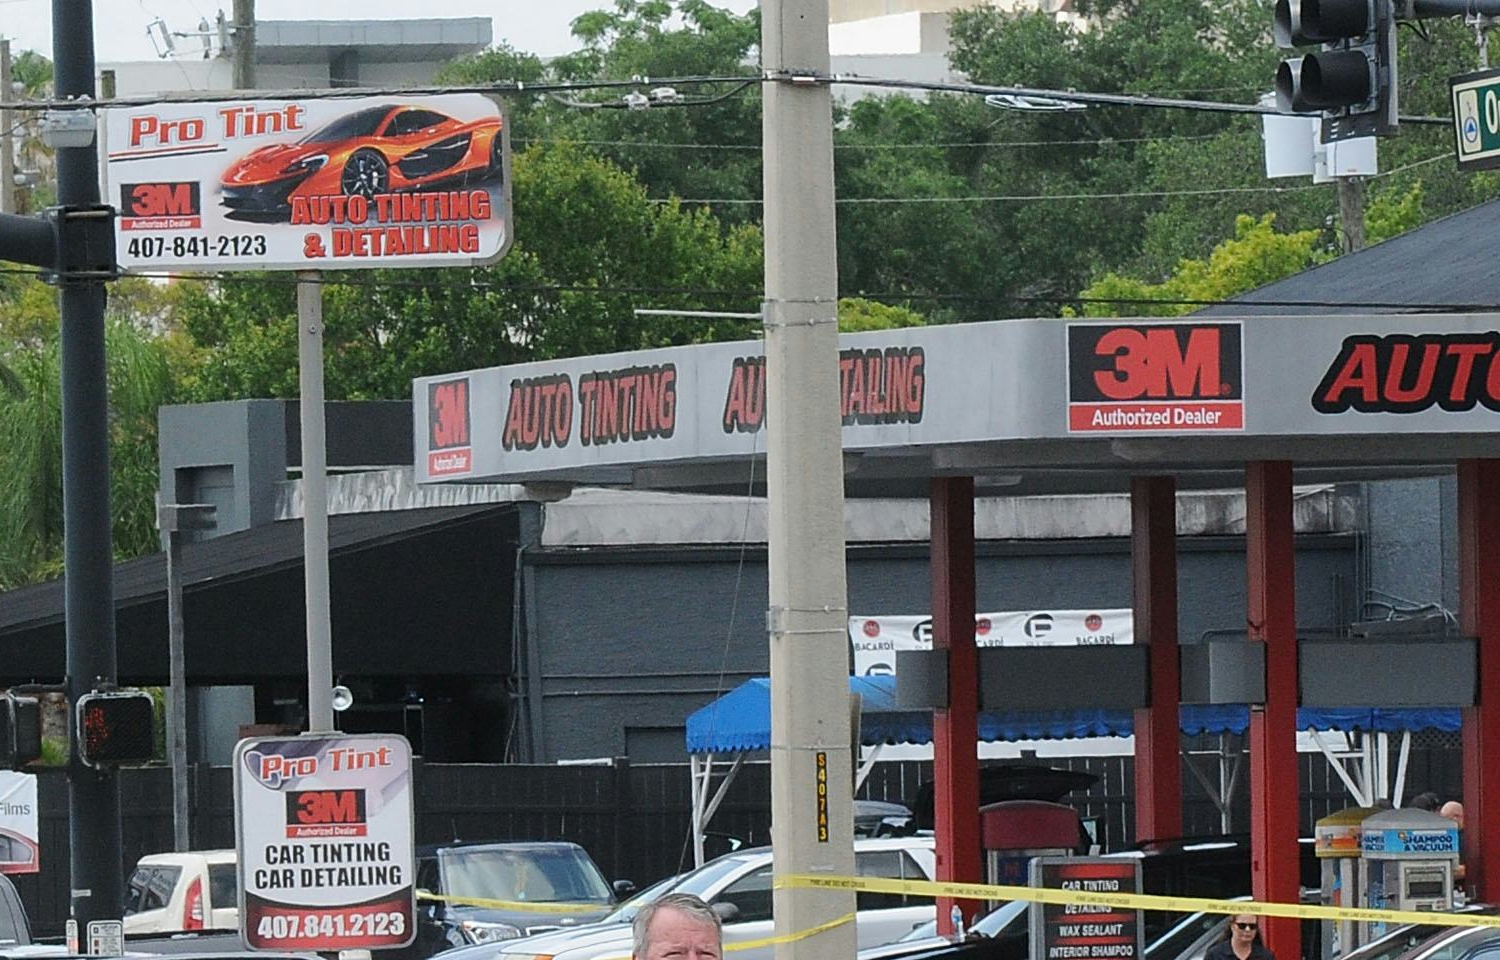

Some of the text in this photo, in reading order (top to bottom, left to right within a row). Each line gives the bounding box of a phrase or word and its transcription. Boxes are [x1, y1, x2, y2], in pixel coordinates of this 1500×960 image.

[130, 104, 306, 147] Pro Tint
[1485, 89, 1500, 134] O
[130, 184, 195, 216] 3M
[290, 190, 491, 225] AUTO TINTING
[131, 218, 192, 230] Authorized Dealer
[127, 235, 267, 260] 407-841-2123
[302, 225, 480, 258] & DETAILING
[1093, 328, 1221, 399] 3M
[1322, 342, 1500, 402] AUT
[434, 383, 469, 448] 3M
[503, 366, 676, 448] AUTO TINTING
[1092, 408, 1222, 427] Authorized Dealer
[260, 747, 392, 781] Pro Tint
[297, 792, 357, 823] 3M
[818, 754, 827, 840] S407A3
[296, 826, 357, 836] Authorized Dealer
[265, 842, 391, 865] CAR TINTING
[255, 865, 402, 889] CAR DETAILING
[1062, 880, 1119, 891] CAR TINTING
[257, 912, 405, 939] 407.841.2123
[1059, 924, 1123, 937] WAX SEALANT
[1050, 945, 1133, 957] INTERIOR SHAMPOO
